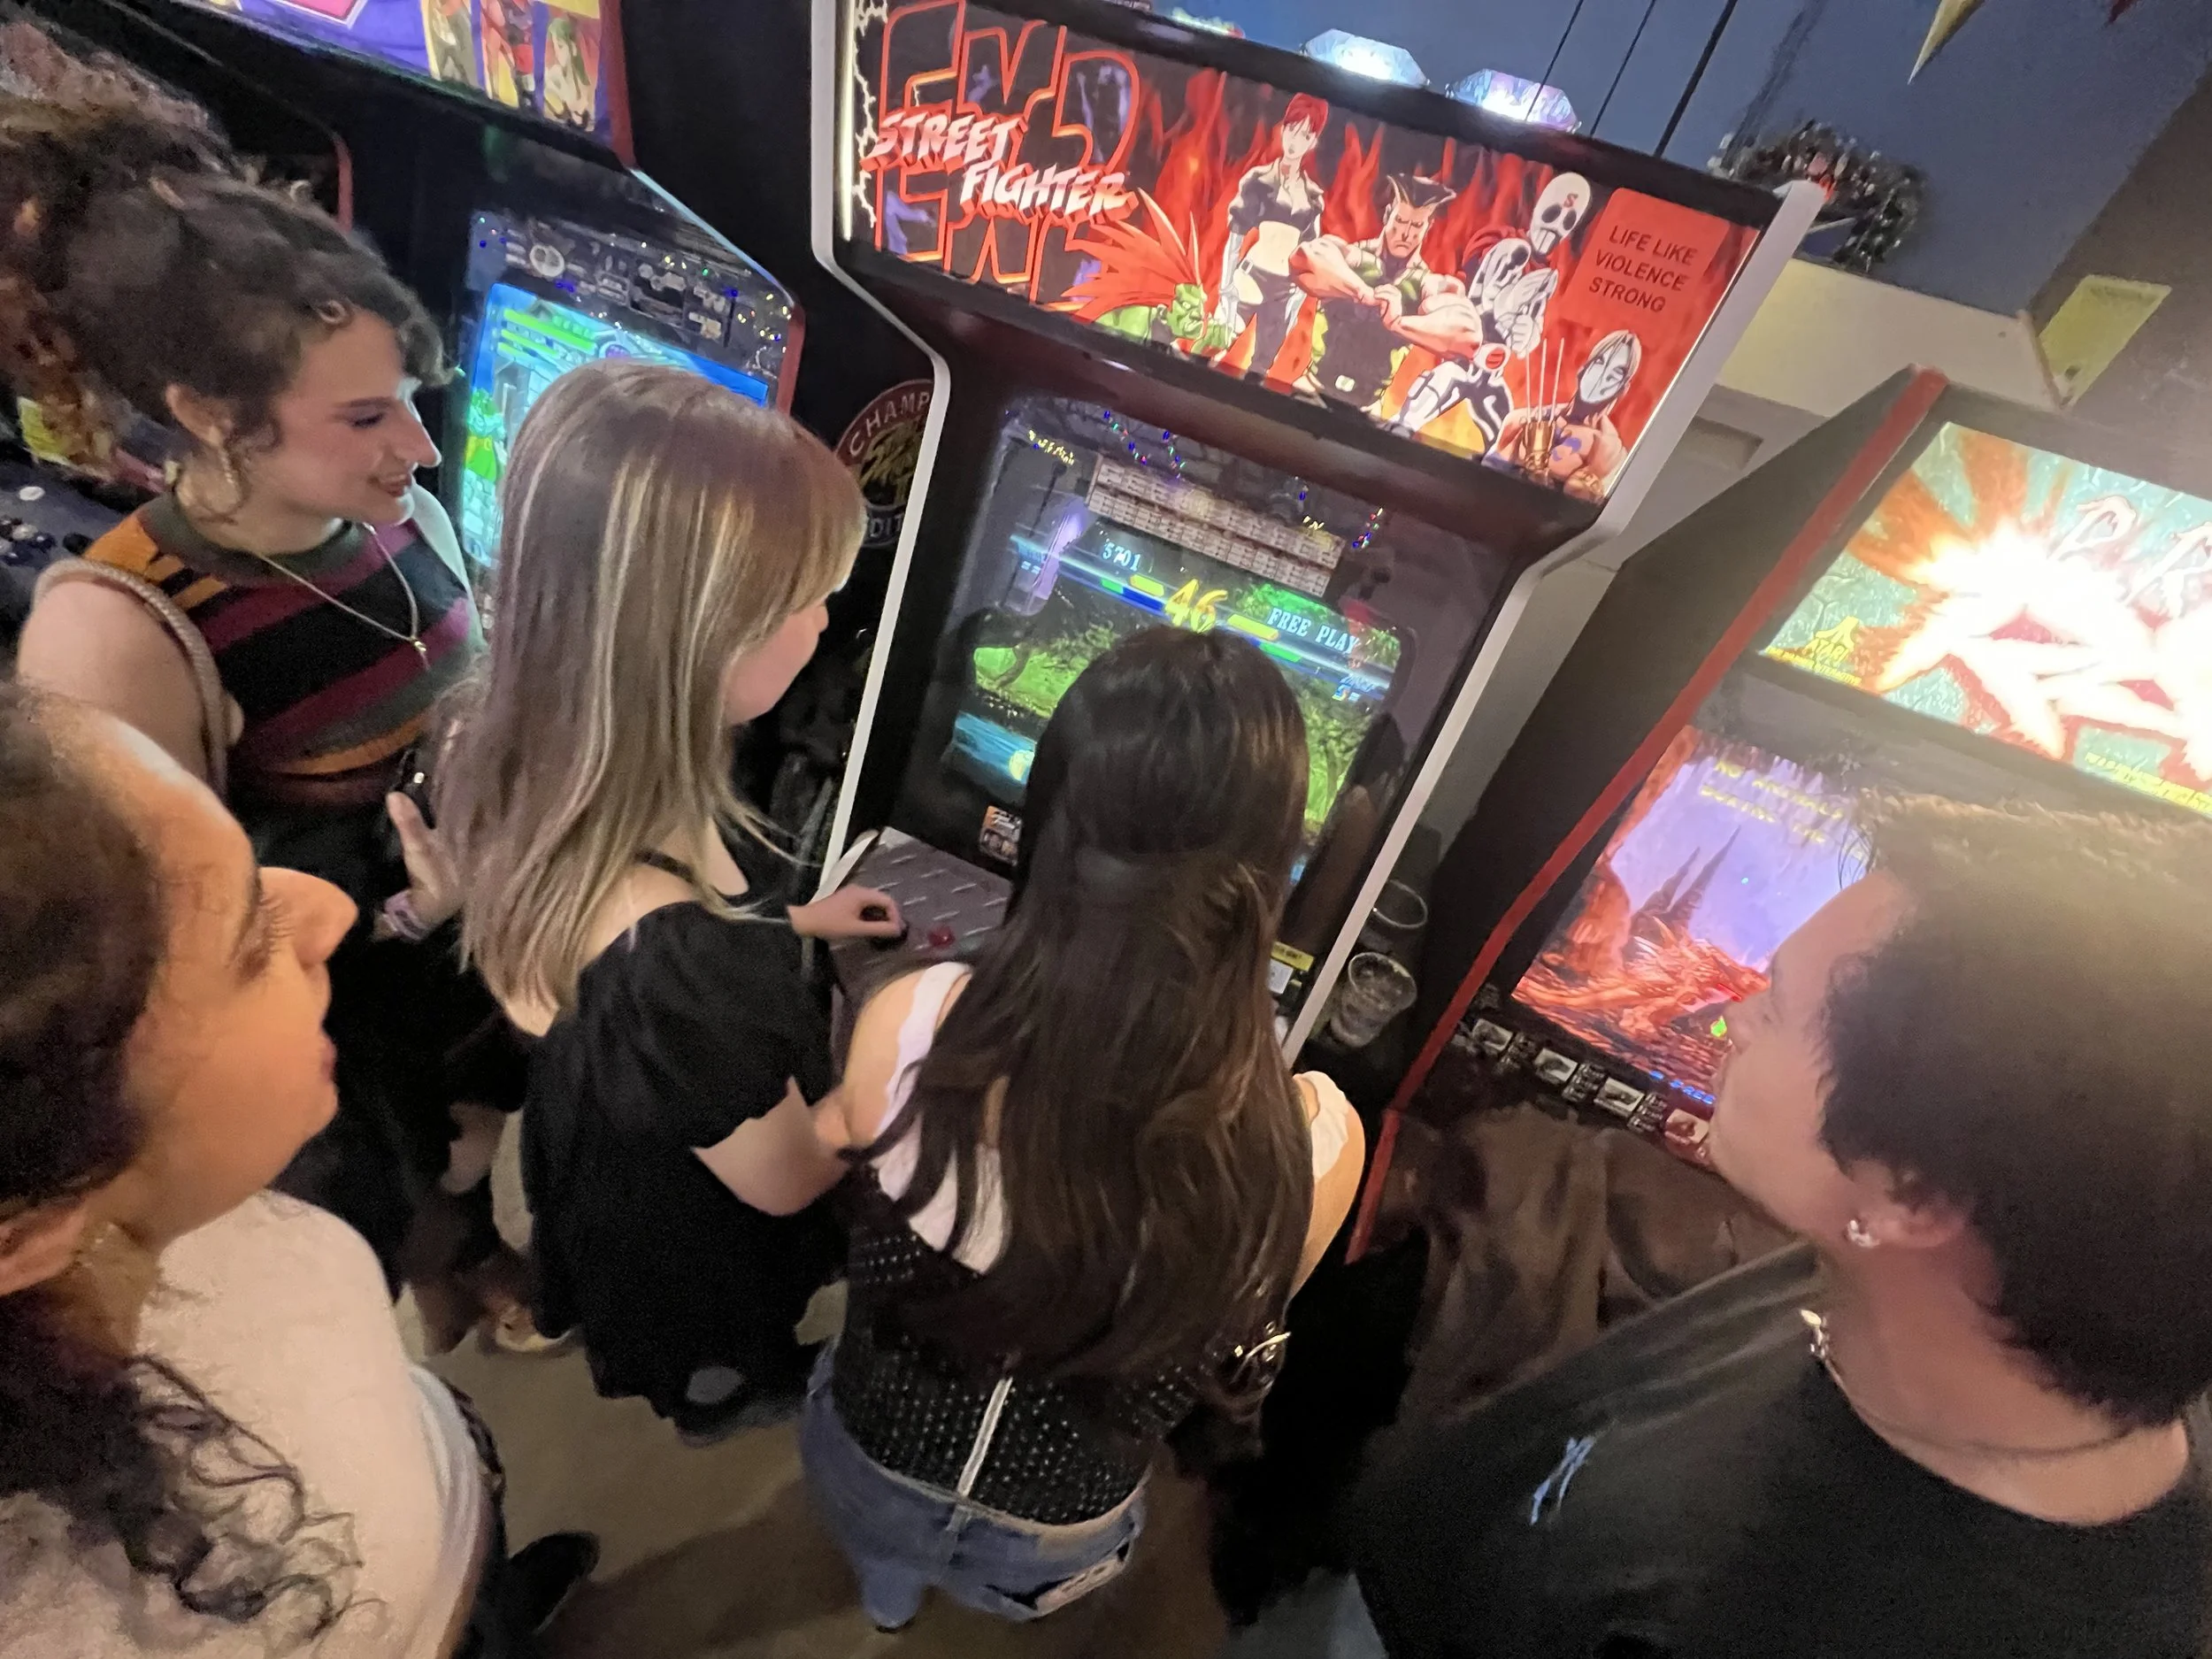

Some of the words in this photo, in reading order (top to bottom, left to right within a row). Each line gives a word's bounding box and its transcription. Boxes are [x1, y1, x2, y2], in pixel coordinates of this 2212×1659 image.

[864, 108, 1027, 172] STREET
[959, 162, 1138, 222] FIGHTER
[1609, 225, 1652, 252] LIFE
[1652, 238, 1698, 266] LIKE
[1595, 249, 1691, 292] VIOLENCE
[1588, 276, 1666, 312] STRONG
[1164, 578, 1228, 634] 46
[1266, 607, 1311, 637] FREE
[1315, 625, 1361, 655] PLAY
[1805, 639, 1850, 670] ATARI
